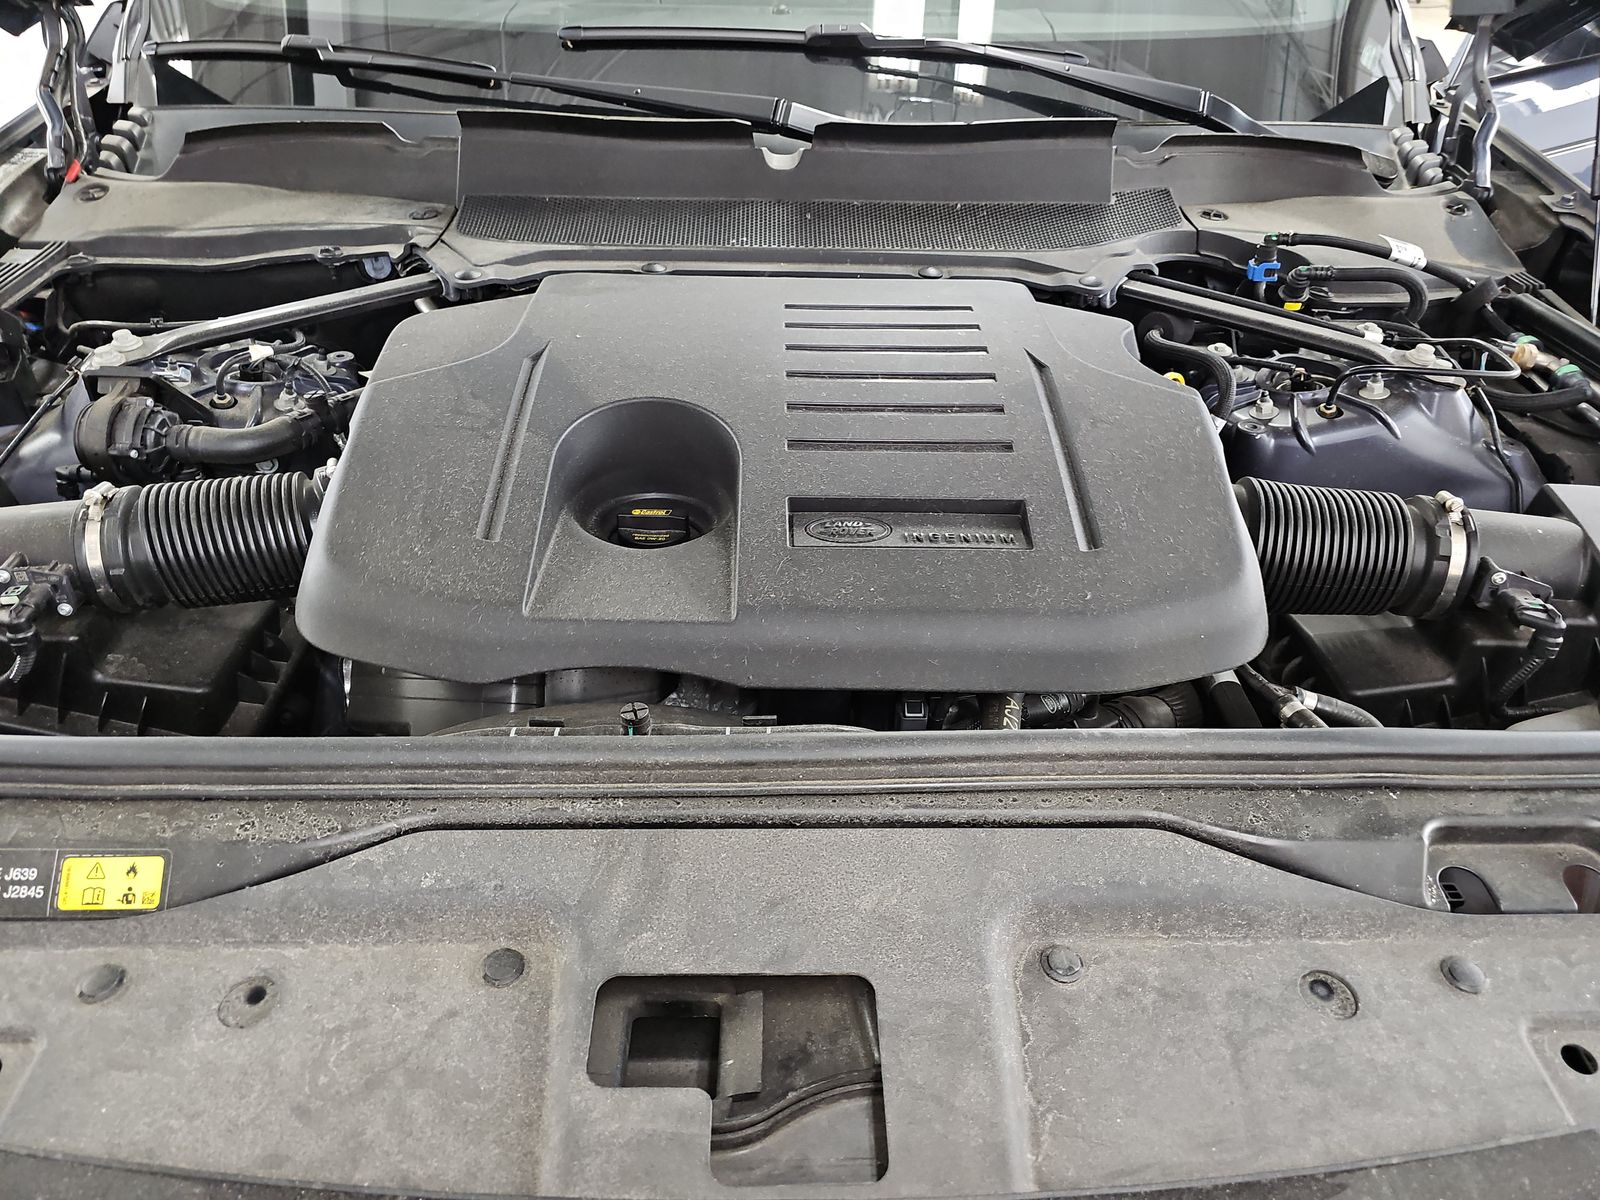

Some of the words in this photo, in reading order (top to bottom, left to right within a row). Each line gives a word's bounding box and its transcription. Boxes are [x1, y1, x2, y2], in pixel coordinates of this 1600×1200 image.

[825, 520, 863, 528] LAND
[829, 527, 875, 538] ROVER
[903, 531, 1018, 546] INGENIUM
[1003, 696, 1020, 730] AJ2
[4, 867, 38, 881] J639
[2, 885, 45, 899] J2845
